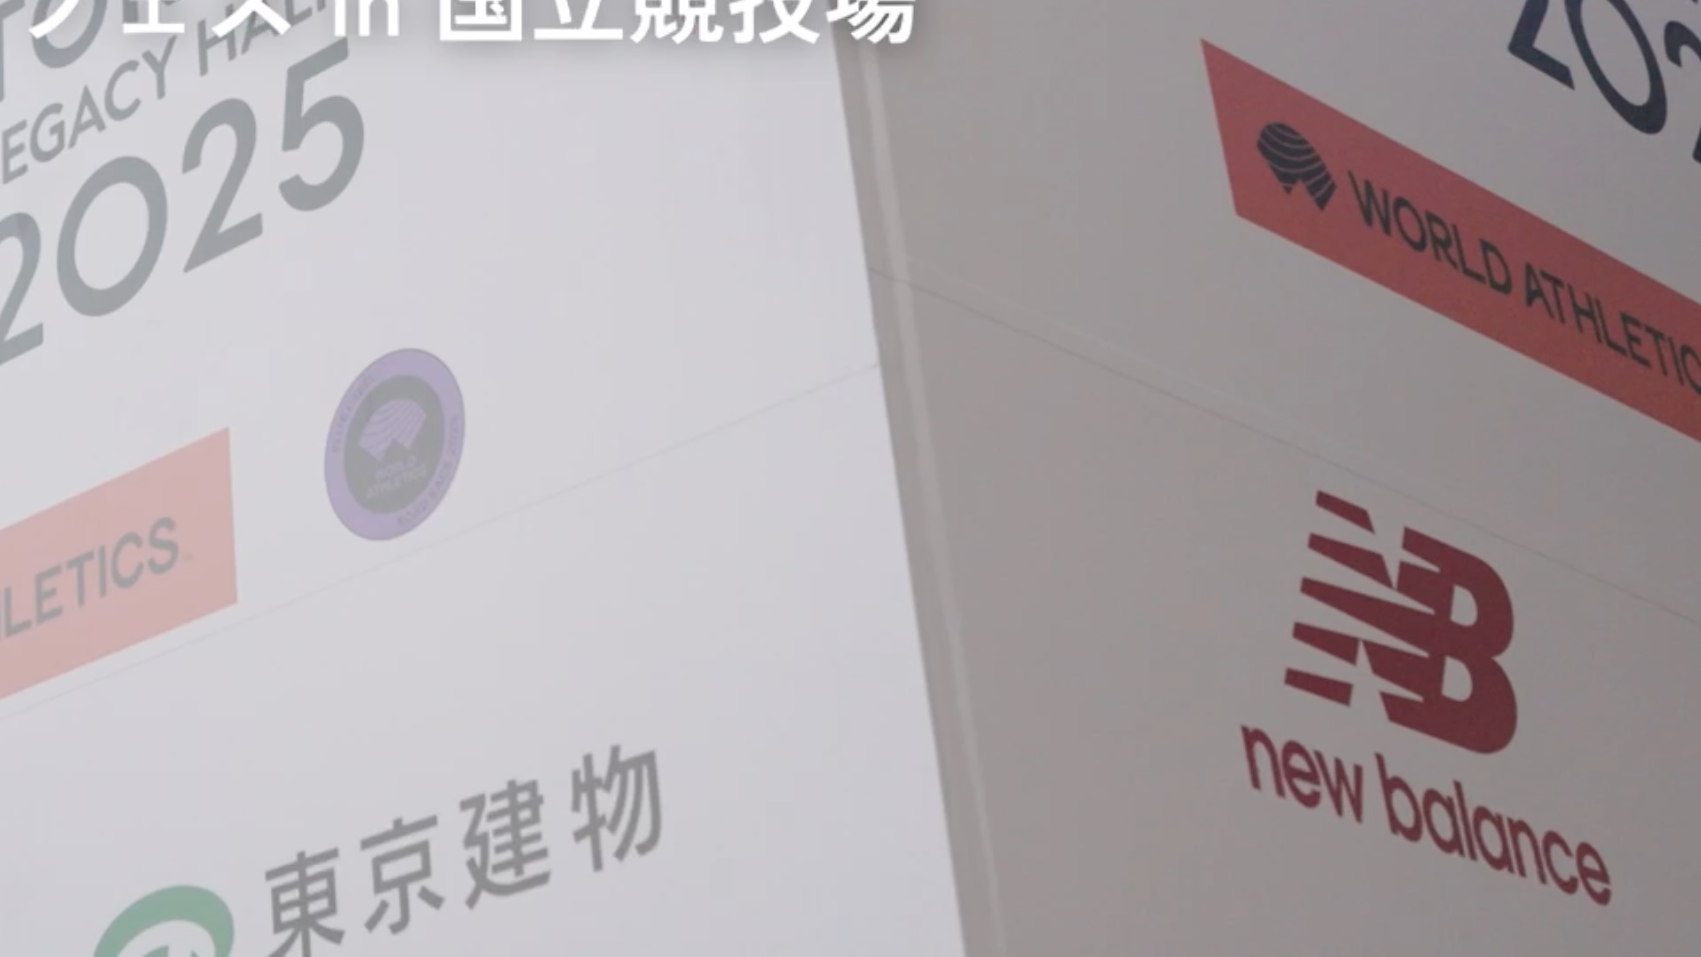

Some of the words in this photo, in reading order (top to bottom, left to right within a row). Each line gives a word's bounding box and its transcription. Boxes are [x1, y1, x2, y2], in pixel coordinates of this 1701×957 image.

[1346, 168, 1513, 296] WORLD
[264, 744, 662, 957] 東京建物
[1240, 724, 1363, 824] new
[1375, 751, 1613, 907] balance
